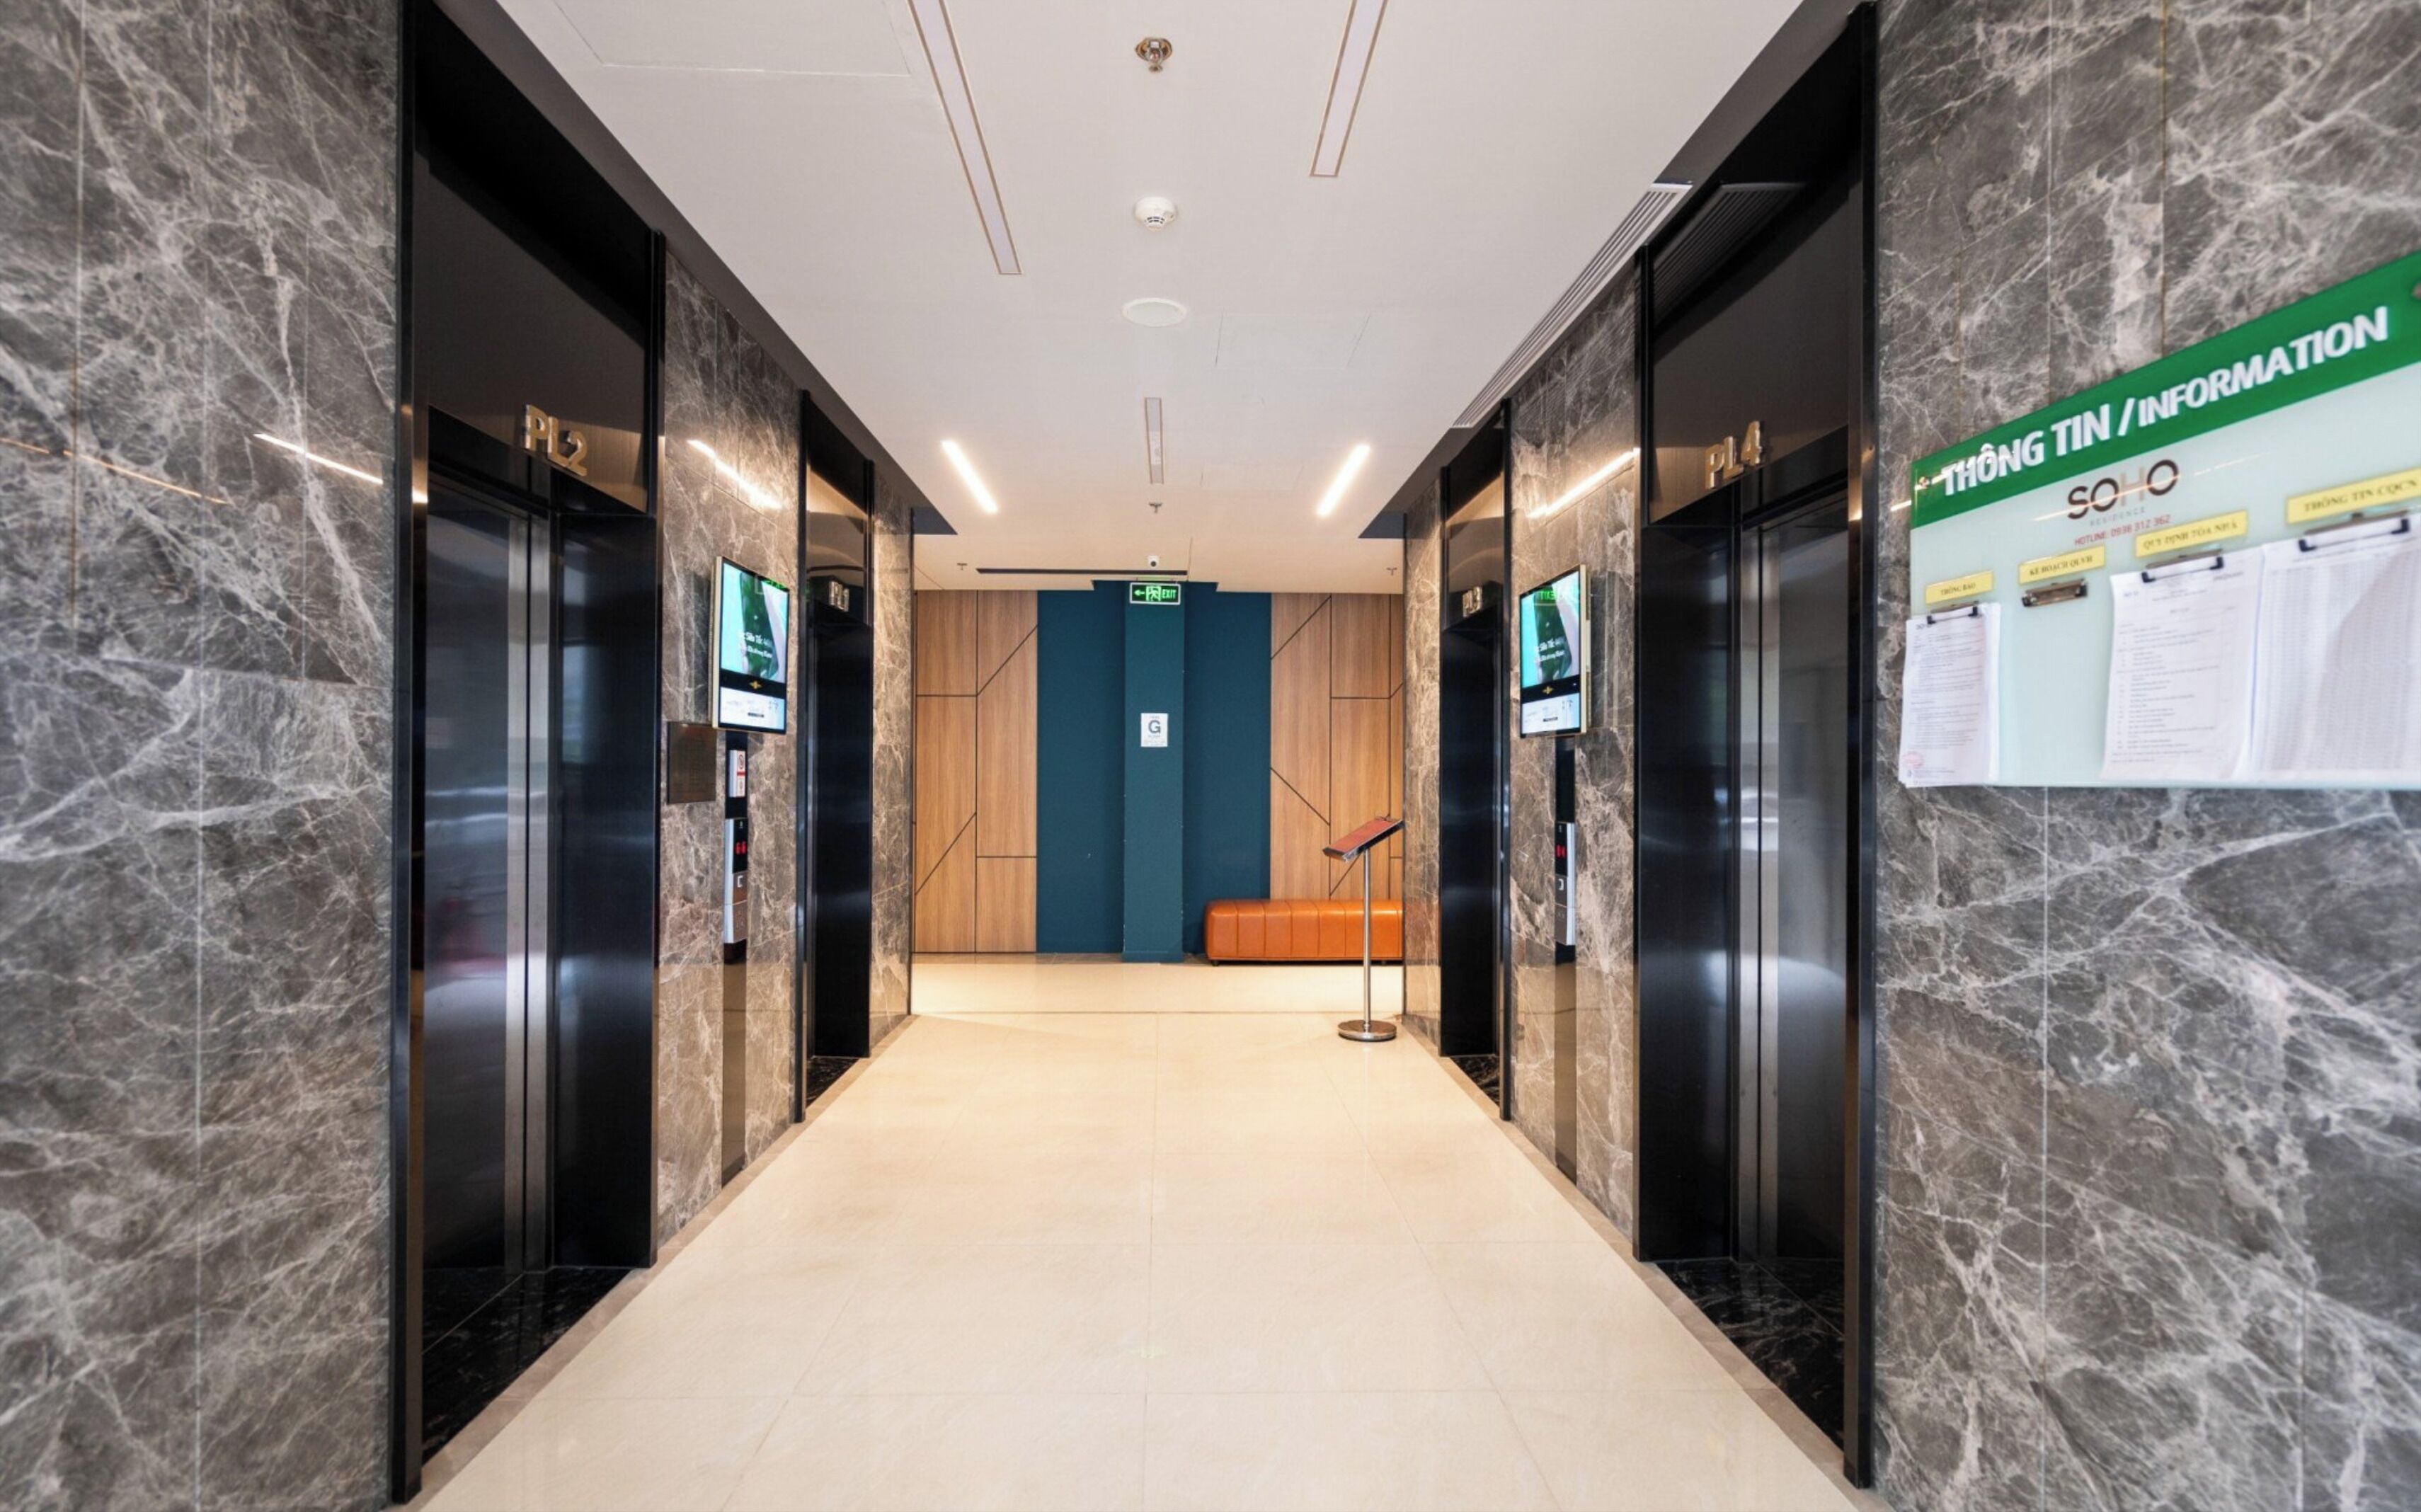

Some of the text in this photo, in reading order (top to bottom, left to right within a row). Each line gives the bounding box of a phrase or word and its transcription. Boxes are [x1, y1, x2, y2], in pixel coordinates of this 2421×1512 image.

[525, 404, 587, 476] PL2
[1705, 420, 1763, 490] PL4
[1940, 430, 2044, 496] THÔNG
[2051, 403, 2110, 456] TIN
[2068, 459, 2179, 520] SOHO
[1162, 588, 1177, 599] EXIT
[1148, 719, 1161, 734] G
